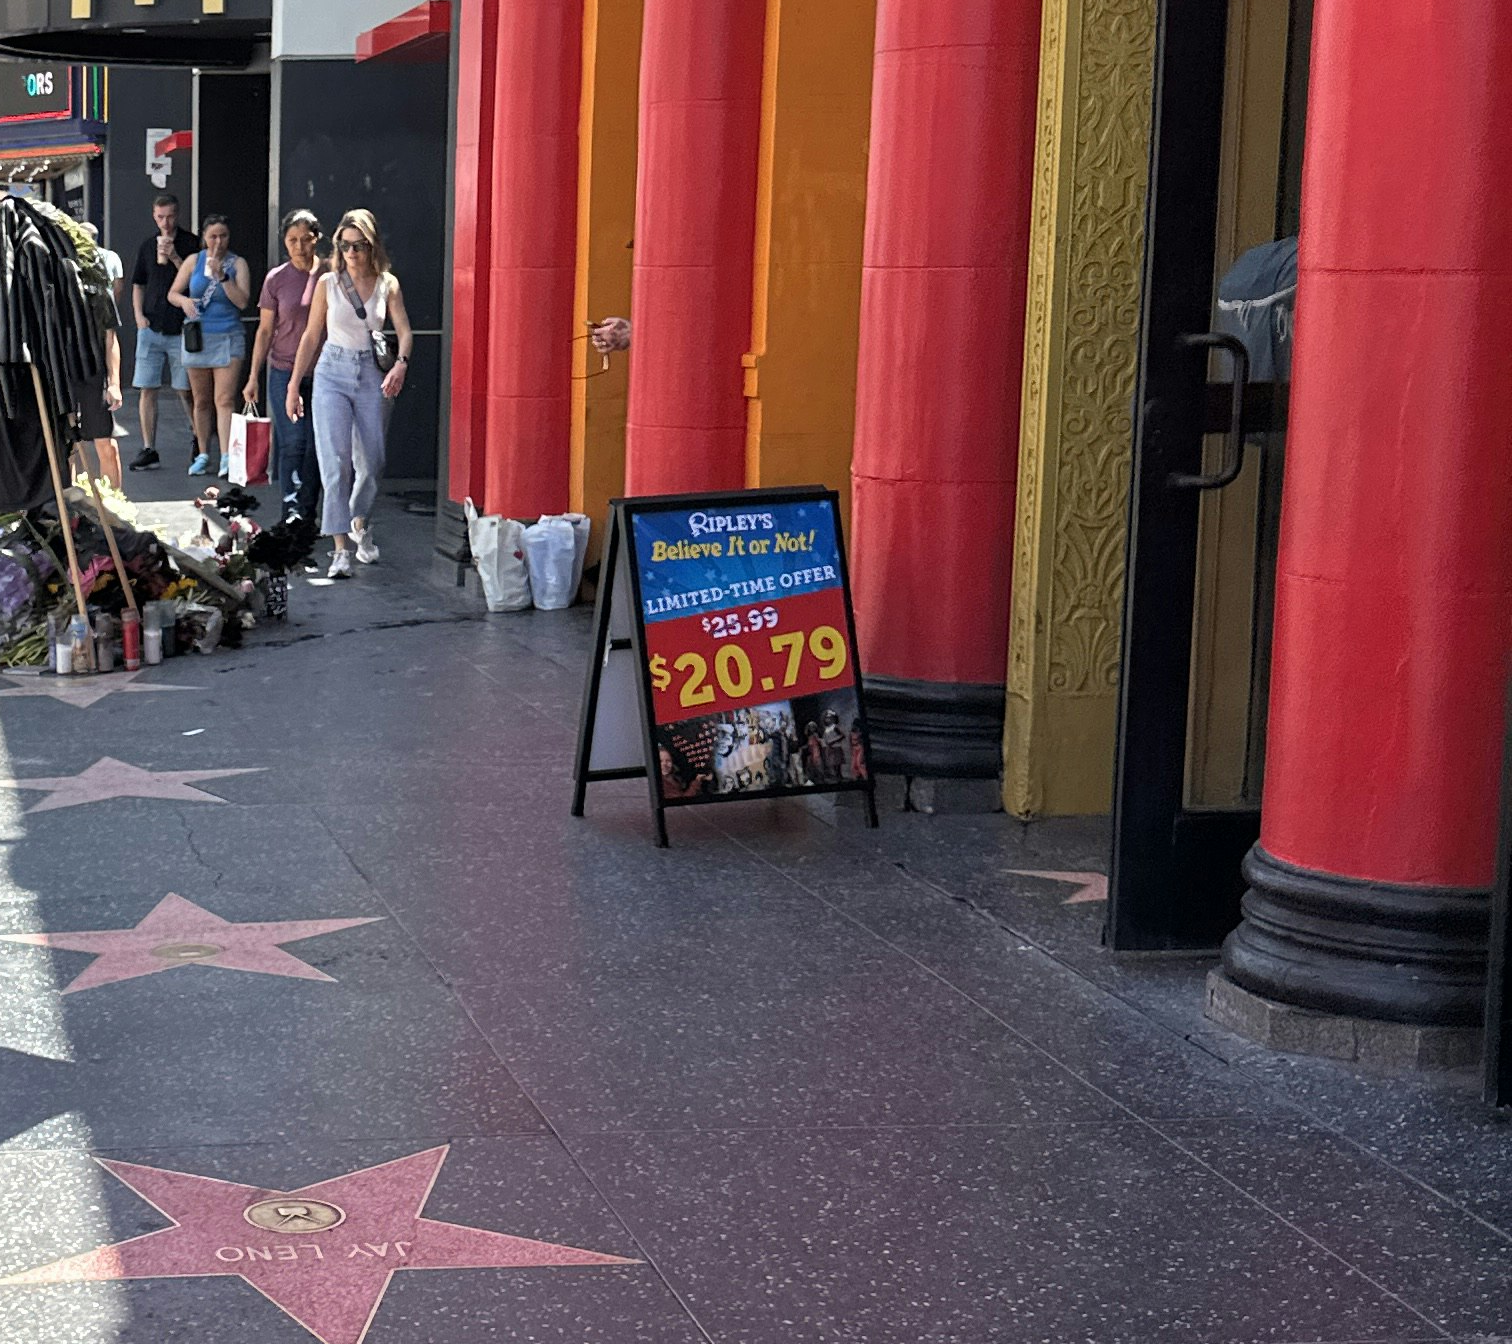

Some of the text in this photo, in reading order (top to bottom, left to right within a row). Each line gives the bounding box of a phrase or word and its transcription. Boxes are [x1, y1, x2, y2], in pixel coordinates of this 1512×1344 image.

[688, 511, 774, 537] RIPLEY'S
[651, 528, 816, 562] Believe It or Not!
[646, 564, 837, 616] LIMITED-TIME OFFER
[701, 606, 779, 639] $25.99
[648, 625, 848, 708] $20.79
[215, 1241, 412, 1263] JAY LENO
